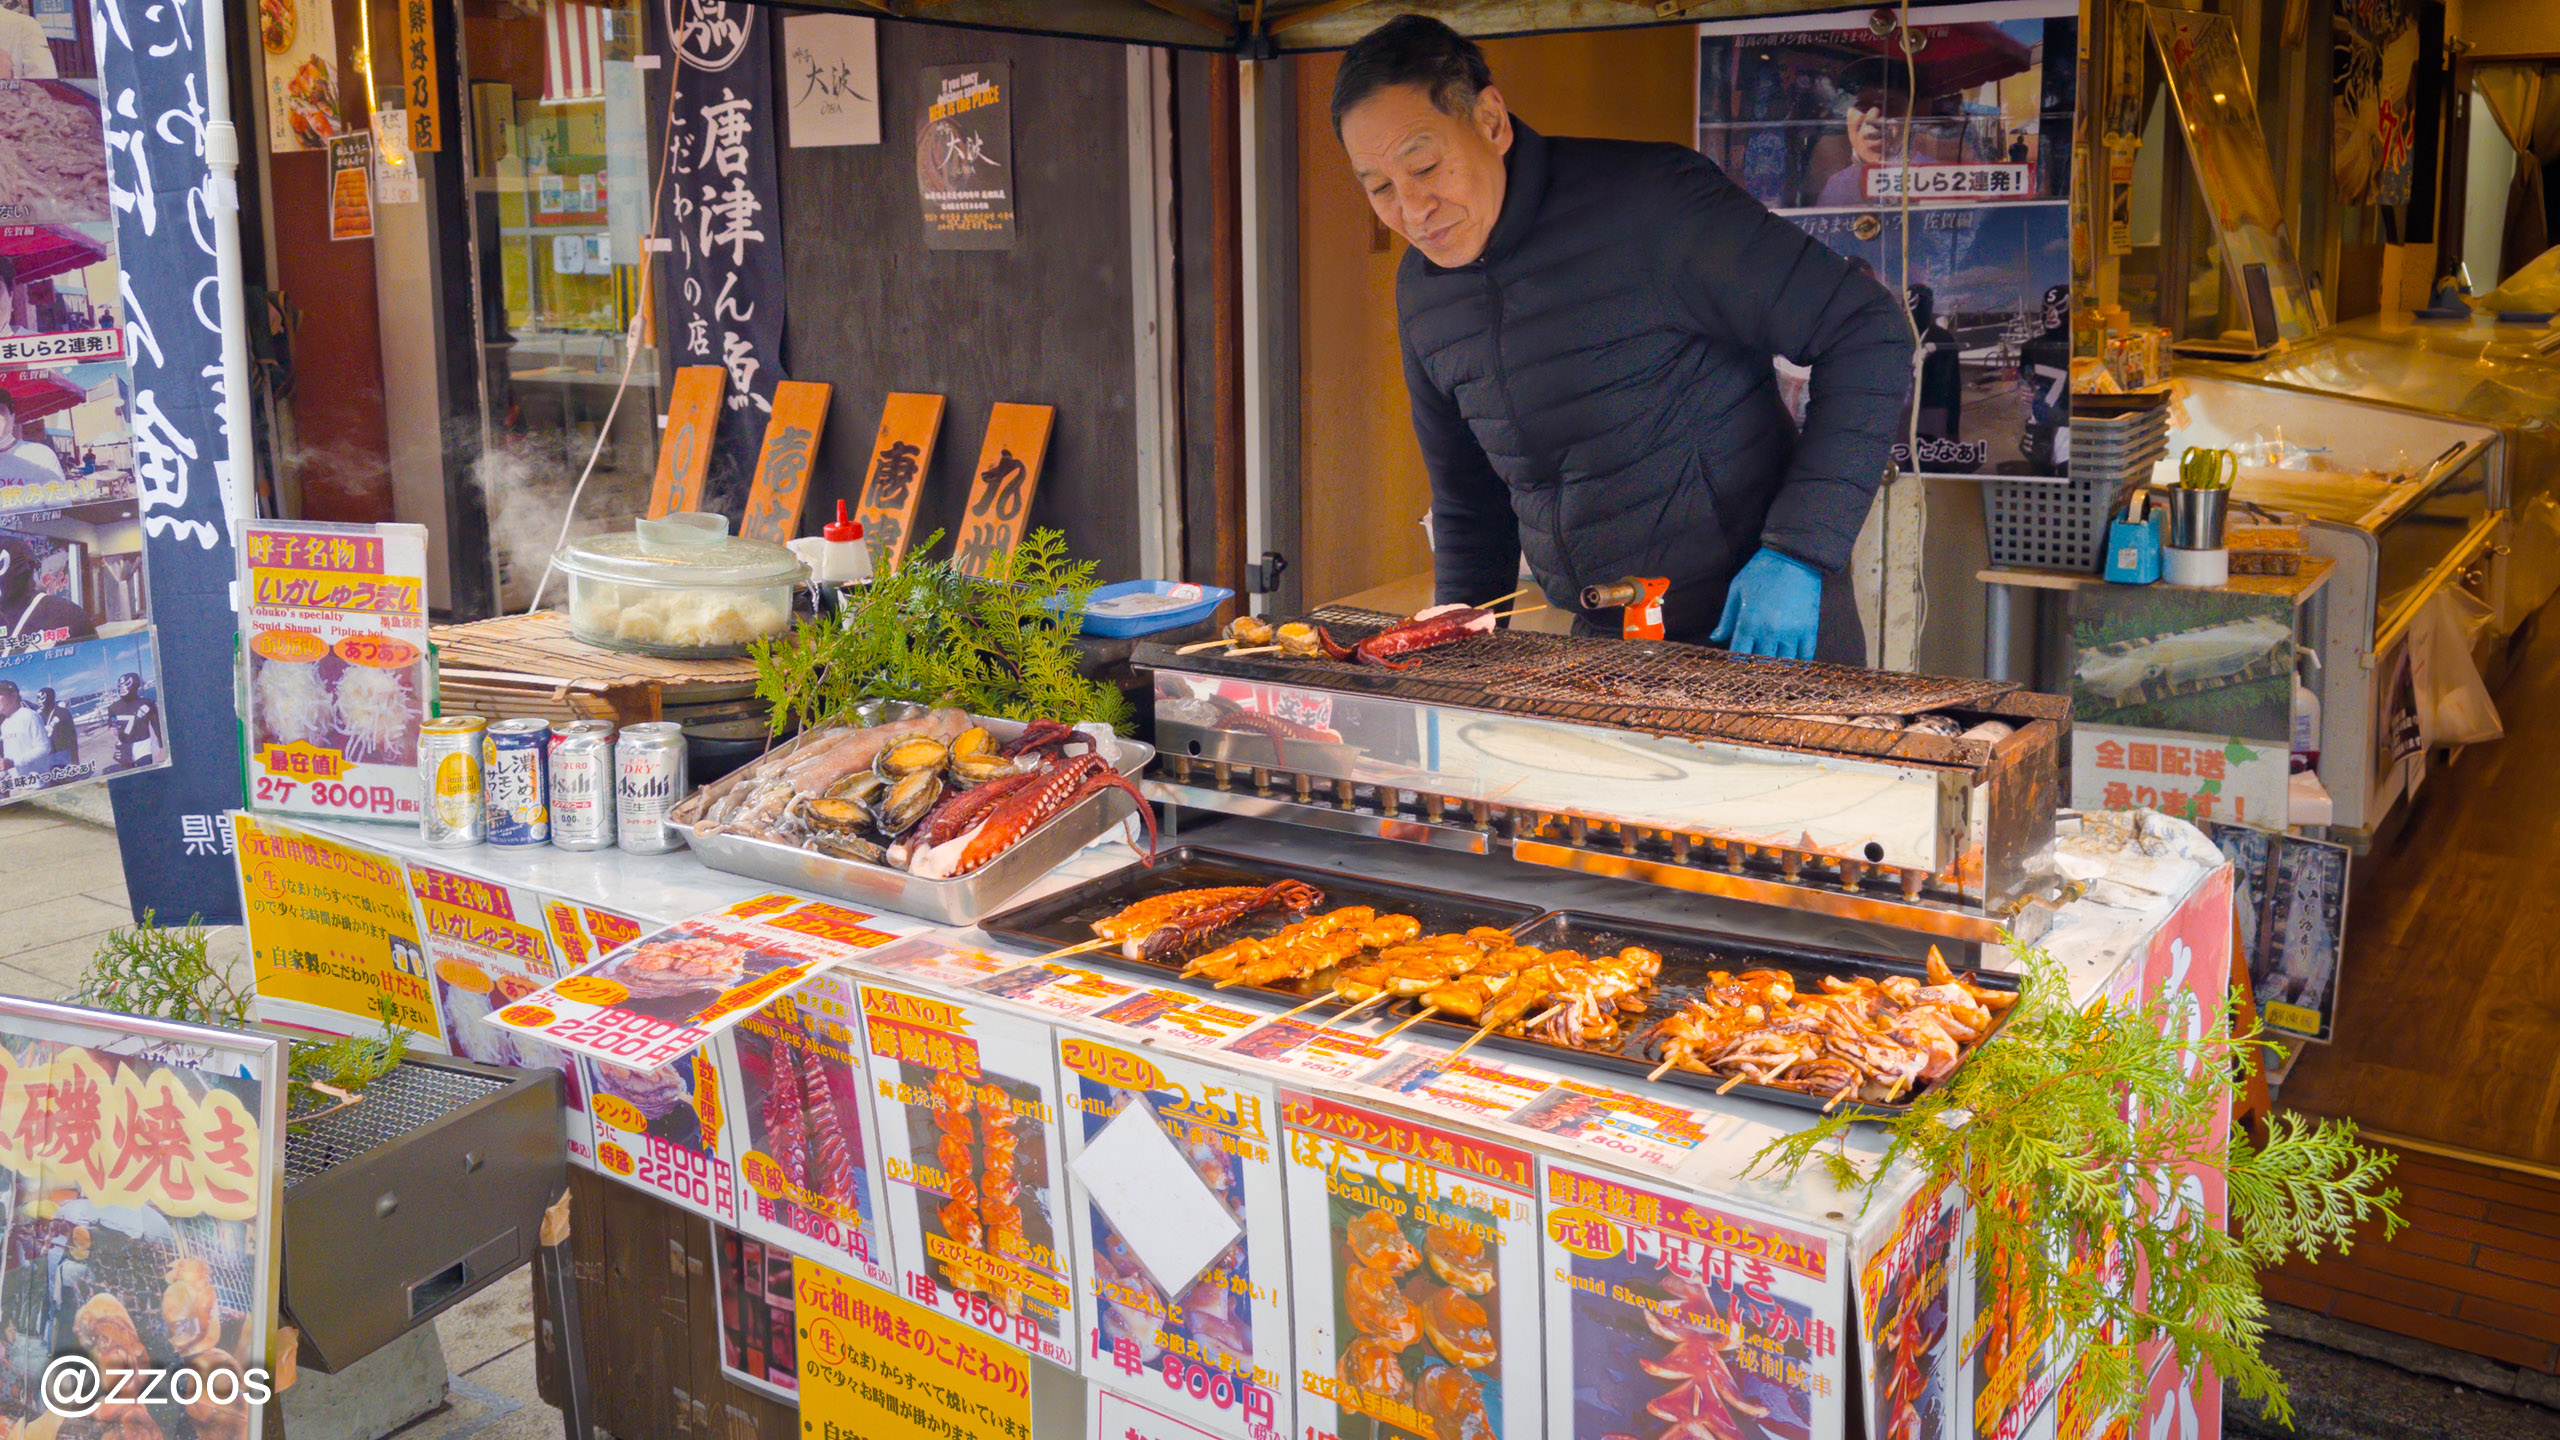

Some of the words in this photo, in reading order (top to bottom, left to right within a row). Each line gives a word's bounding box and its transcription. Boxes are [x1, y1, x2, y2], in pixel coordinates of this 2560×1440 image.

[698, 87, 773, 413] 唐津ん魚
[248, 534, 376, 568] 呼子名物!
[257, 576, 422, 611] いかしゅうまい
[270, 749, 338, 776] 最安値!
[497, 761, 513, 801] レモン
[2095, 739, 2227, 781] 全国配送
[311, 782, 395, 814] 300円
[618, 774, 670, 799] Asahi
[410, 868, 508, 915] 呼子名物!
[429, 908, 551, 961] いかしゅうまい
[779, 1028, 802, 1049] leg
[869, 1020, 981, 1080] 海賊焼き
[1064, 1044, 1156, 1091] こりこり
[593, 1095, 648, 1129] シングル
[1012, 1093, 1054, 1124] grill
[1158, 1080, 1266, 1138] つぶ貝
[1291, 1127, 1439, 1203] ほたて串
[1462, 1148, 1529, 1188] No.1
[1325, 1173, 1408, 1217] Scallop
[1413, 1202, 1508, 1247] skewers
[1554, 1267, 1606, 1297] Squid
[1612, 1283, 1683, 1322] Skewer
[1688, 1310, 1731, 1337] with
[1738, 1325, 1785, 1356] Legs
[1729, 1292, 1836, 1358] いか串
[1162, 1353, 1275, 1431] 800円
